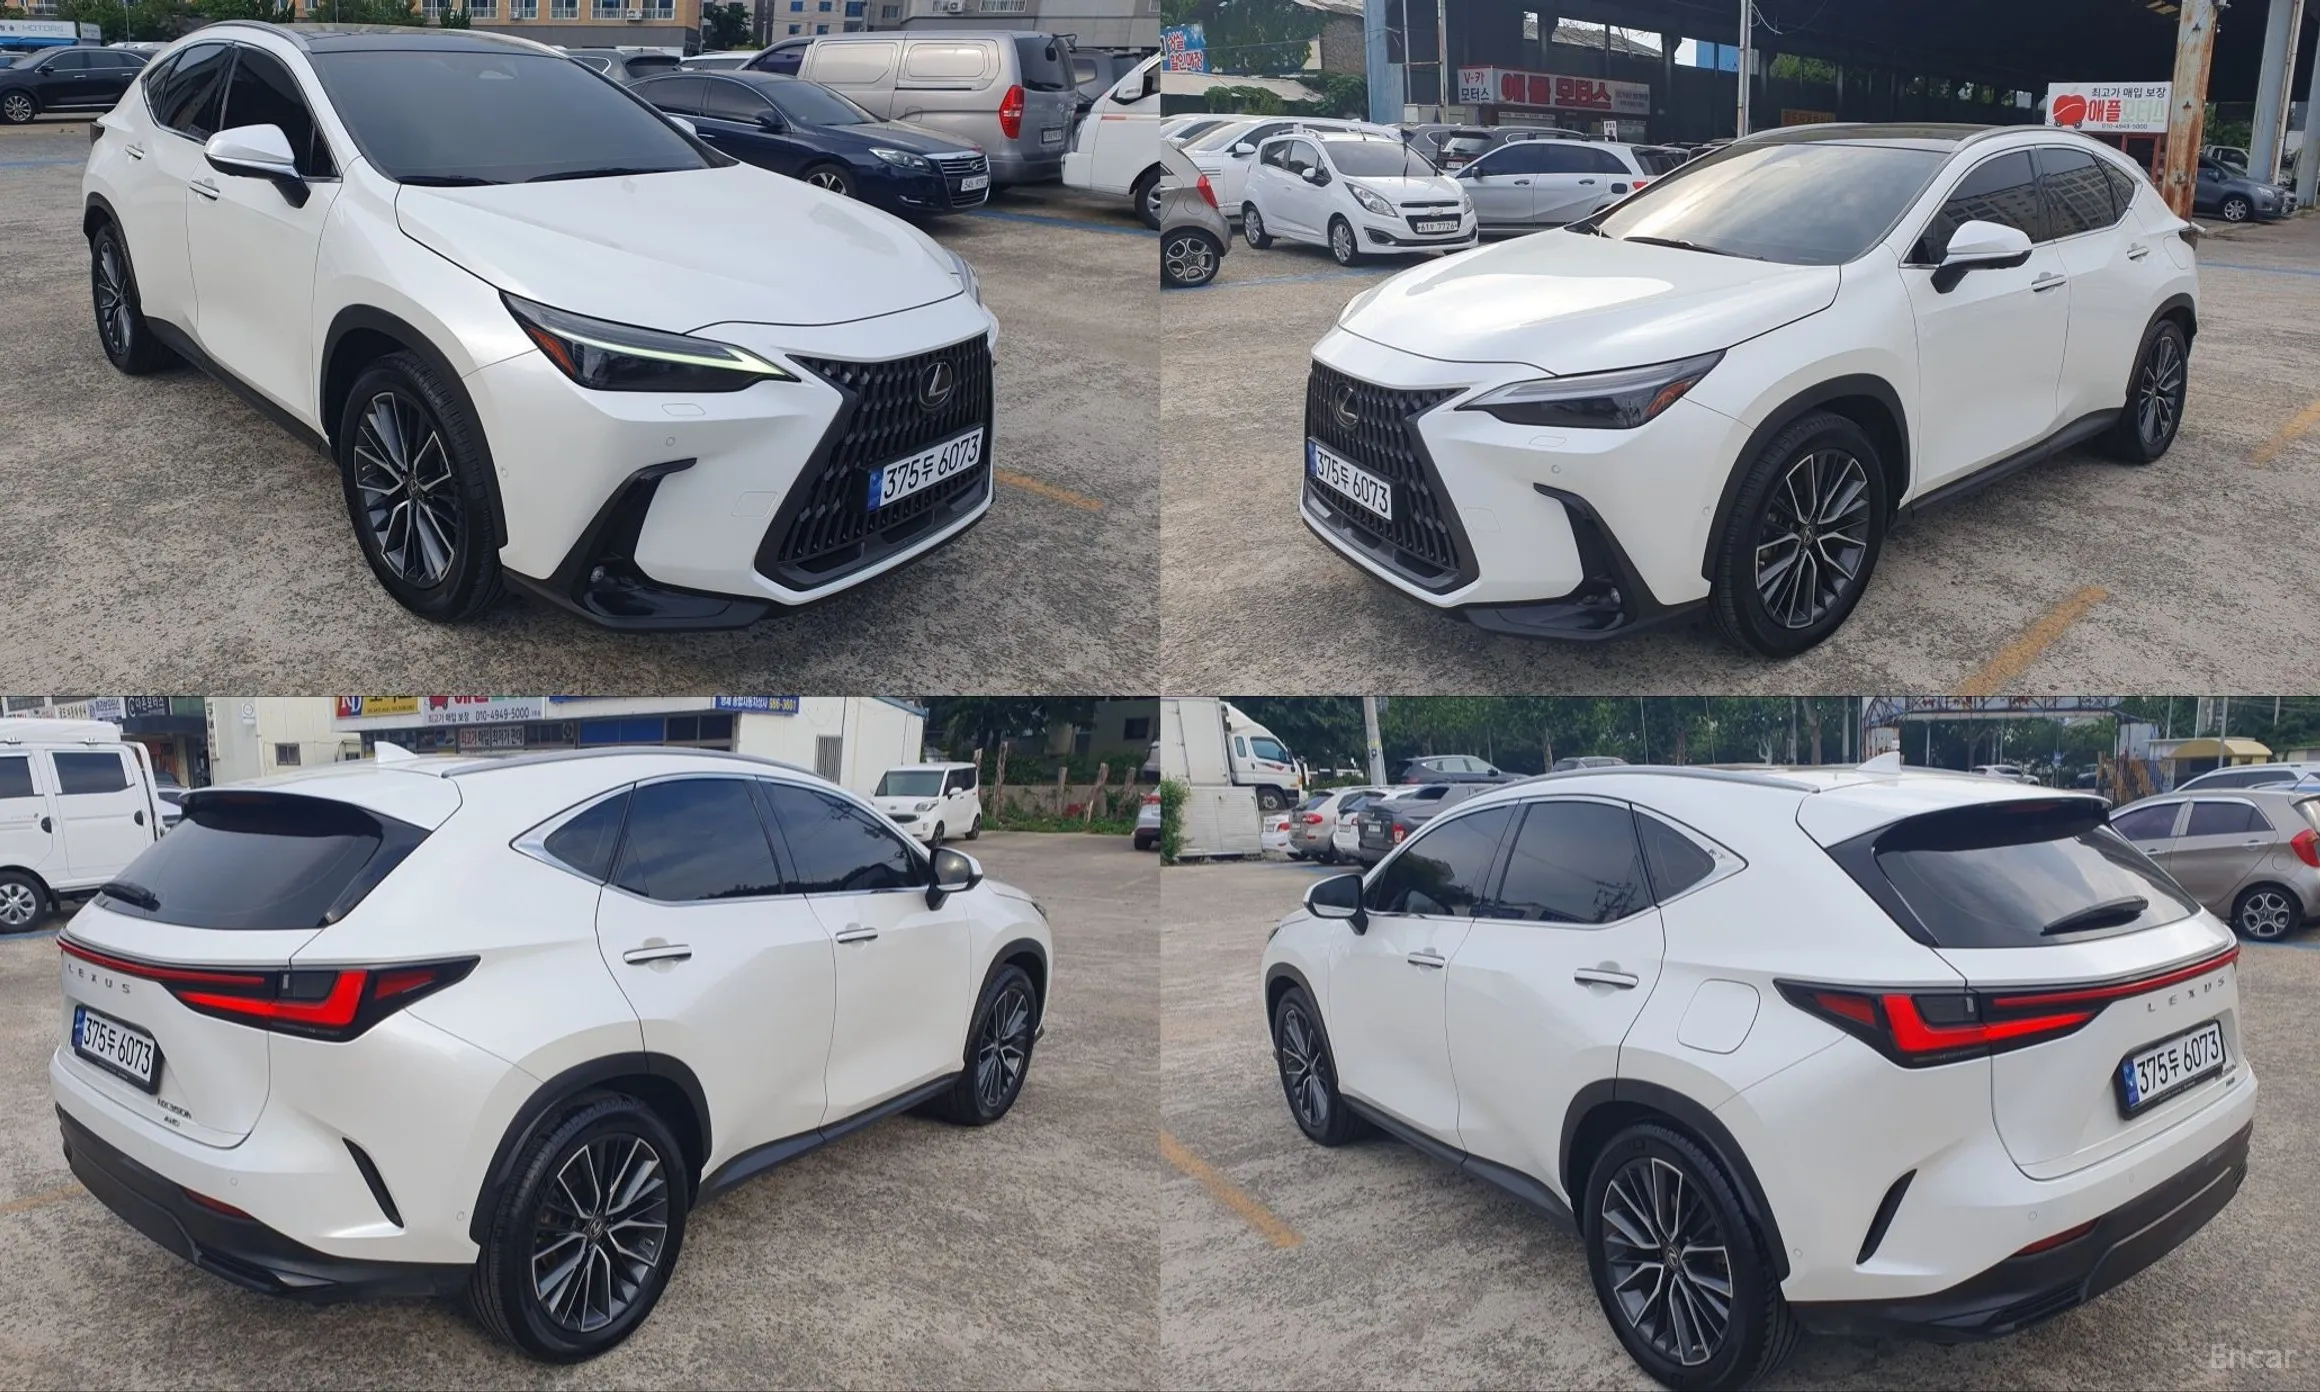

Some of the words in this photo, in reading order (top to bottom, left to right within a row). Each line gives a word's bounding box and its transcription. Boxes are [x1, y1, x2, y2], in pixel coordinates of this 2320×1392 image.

[1167, 31, 1184, 50] 상설
[1461, 87, 1490, 102] 모터스
[2092, 87, 2120, 98] 최고가
[2123, 87, 2142, 98] 매입
[2145, 87, 2166, 98] 보장
[2088, 100, 2121, 122] 애플
[884, 454, 934, 499] 375두
[938, 433, 980, 477] 6073
[1317, 451, 1349, 490] 375두
[1353, 472, 1388, 513] 6073
[475, 707, 530, 721] 010-4949-5000
[68, 963, 131, 994] LEXUS
[2147, 975, 2225, 1012] LEXUS
[84, 1018, 116, 1055] 375두
[118, 1033, 151, 1075] 6073
[2137, 1049, 2179, 1094] 375두
[2183, 1030, 2219, 1072] 6073
